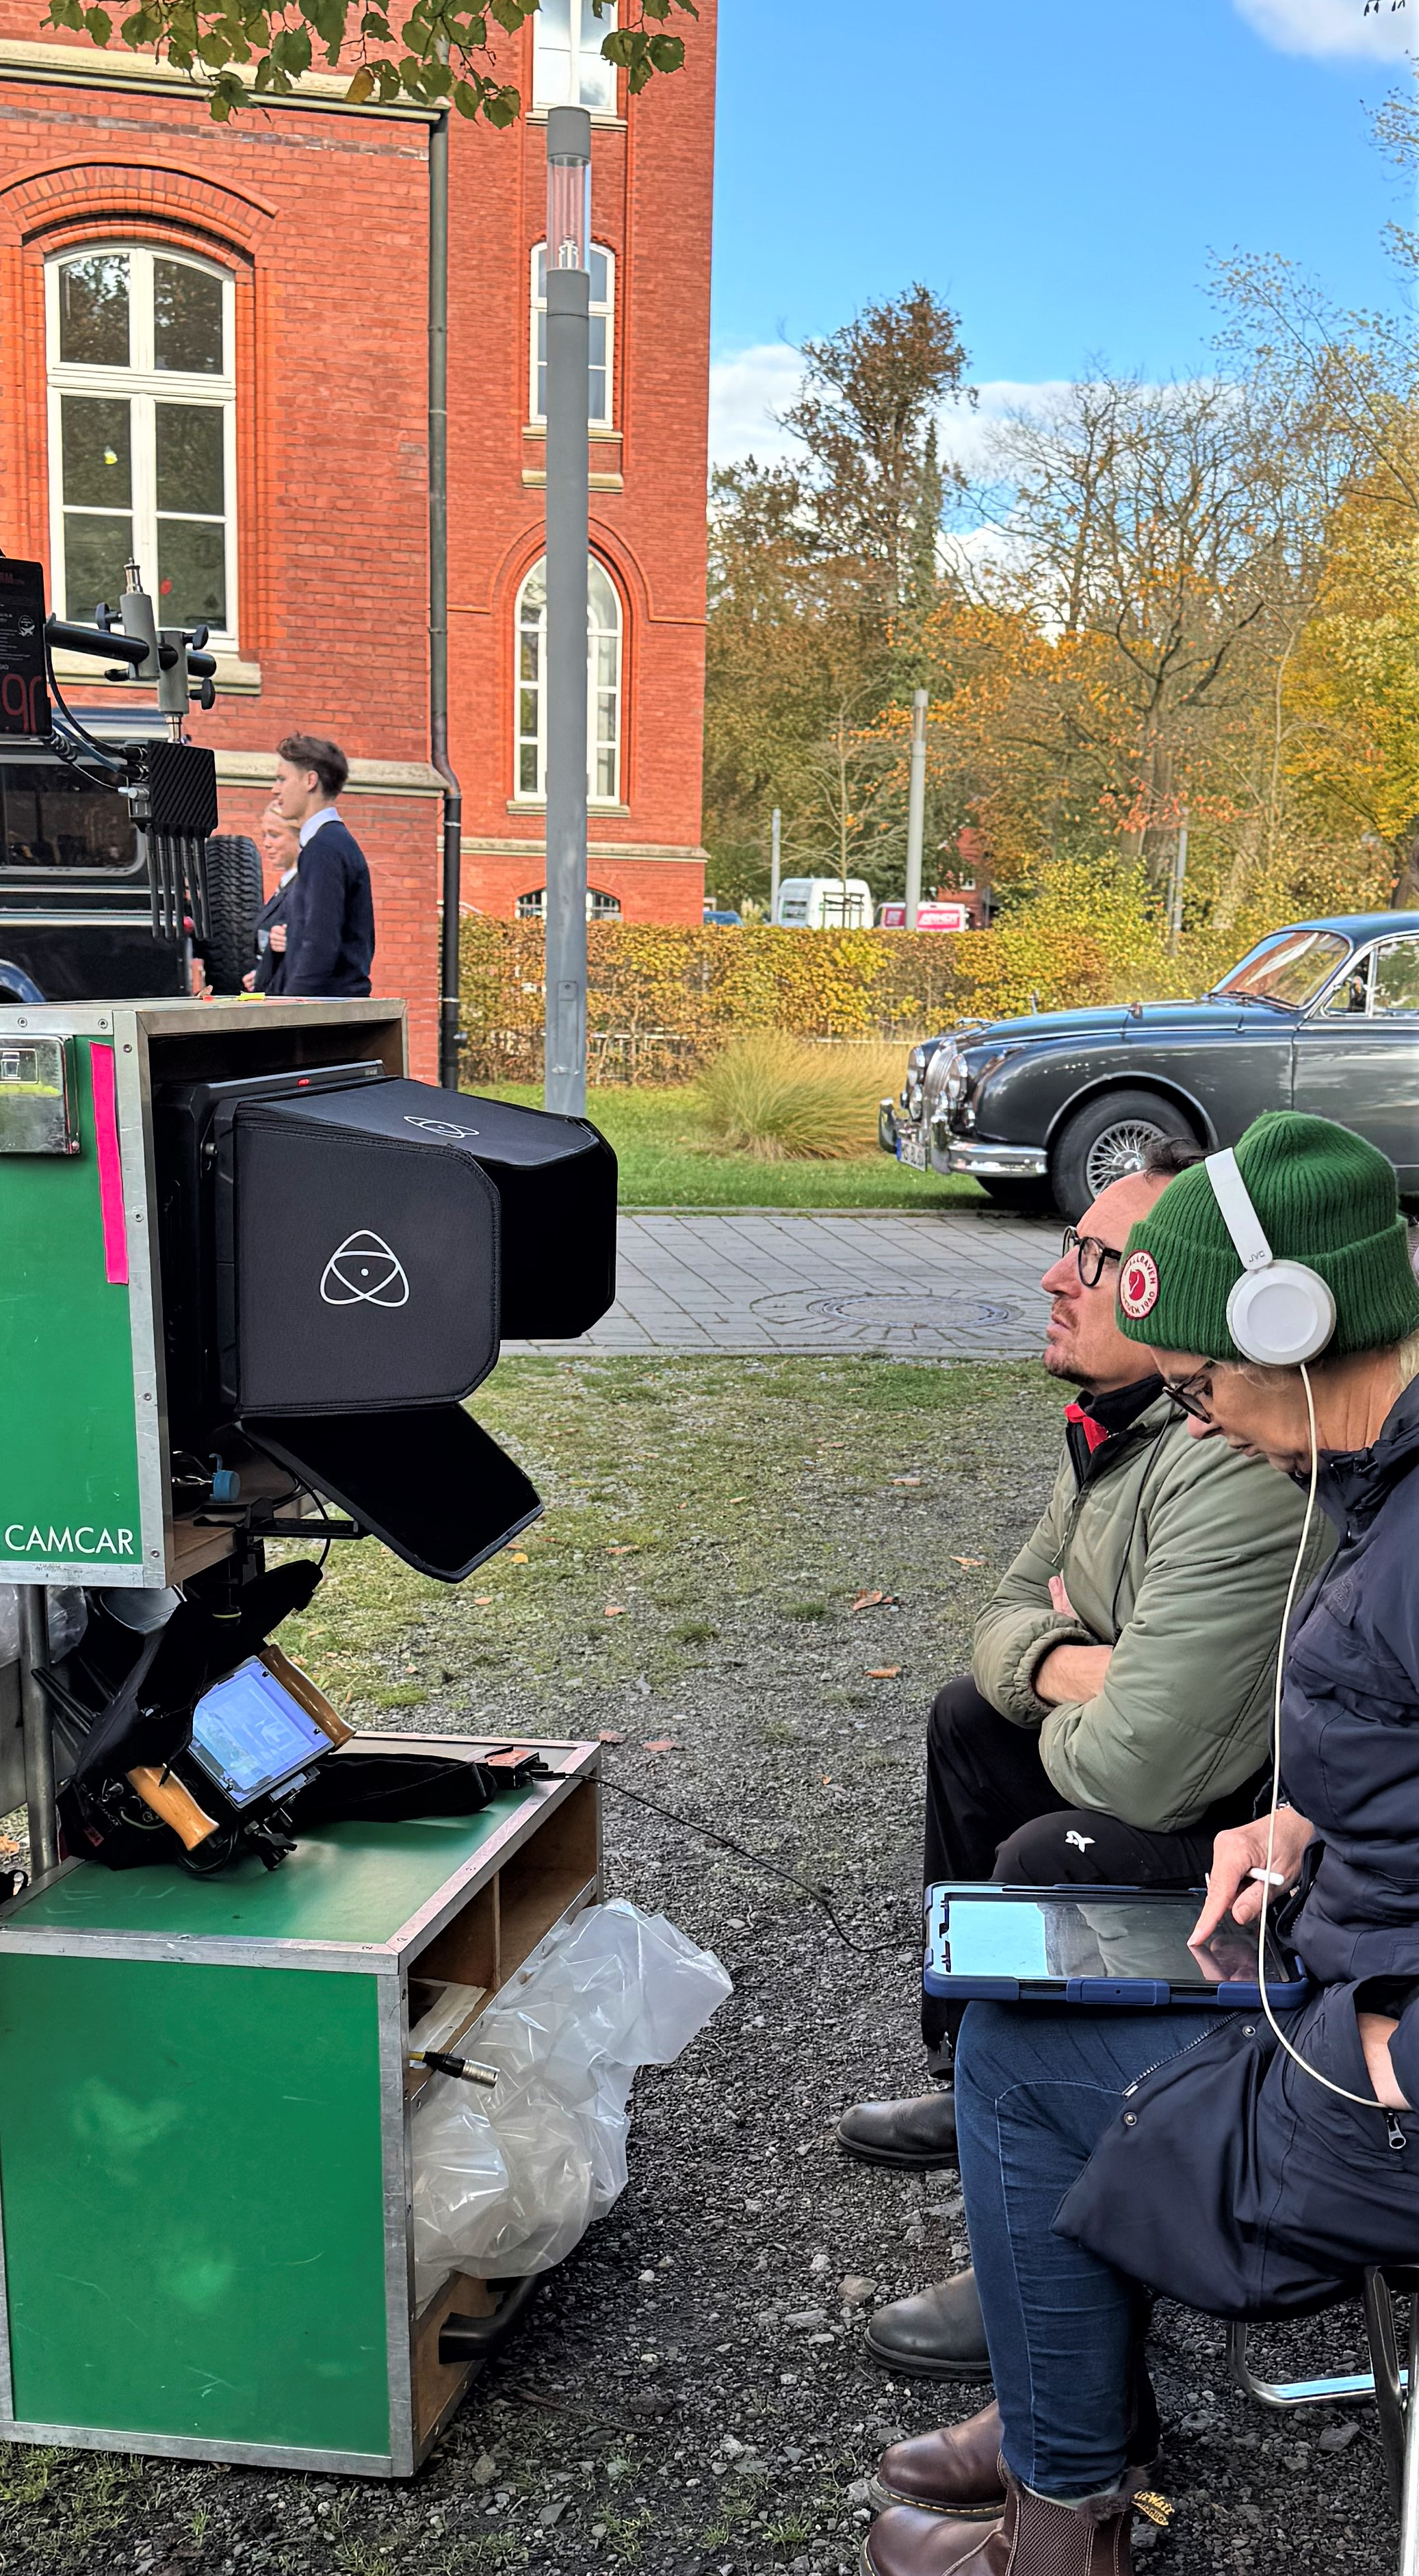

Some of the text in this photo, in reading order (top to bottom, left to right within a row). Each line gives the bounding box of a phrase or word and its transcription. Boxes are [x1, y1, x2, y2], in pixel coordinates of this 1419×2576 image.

[1249, 1250, 1265, 1263] JVC
[5, 1524, 134, 1555] CAMCAR
[1133, 2490, 1175, 2516] AirWair
